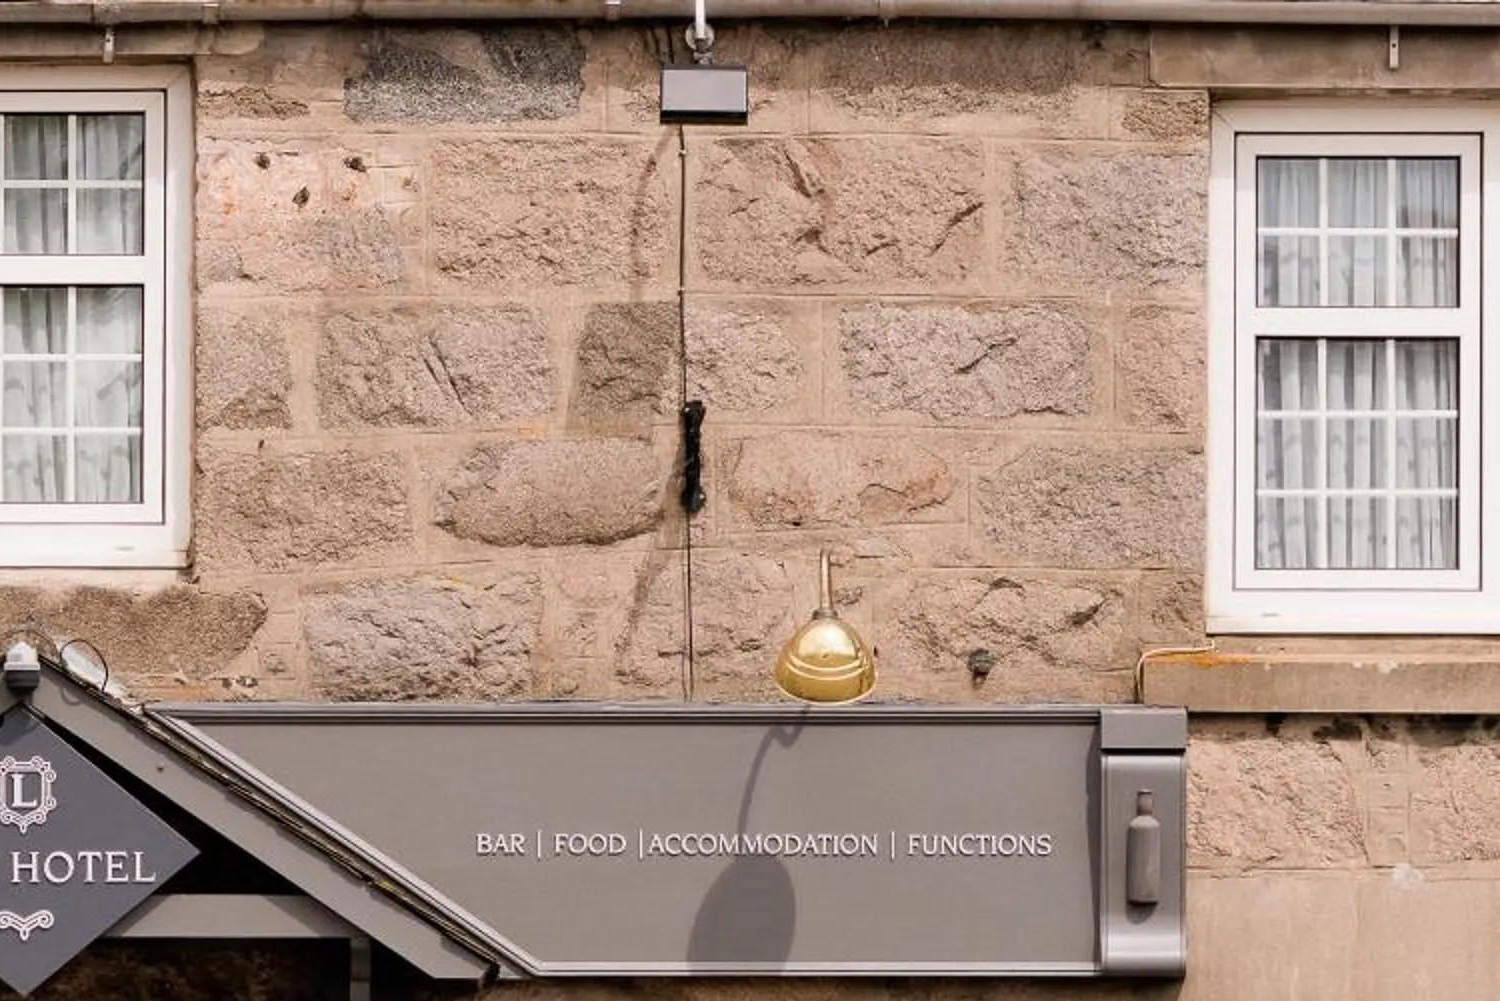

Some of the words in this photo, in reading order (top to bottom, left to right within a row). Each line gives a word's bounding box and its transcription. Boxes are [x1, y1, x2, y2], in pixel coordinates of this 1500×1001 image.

[11, 773, 38, 808] L
[476, 833, 526, 855] BAR
[554, 833, 627, 856] FOOD
[647, 833, 879, 856] ACCOMMODATION
[907, 833, 1053, 856] FUNCTIONS
[11, 850, 157, 883] HOTEL
